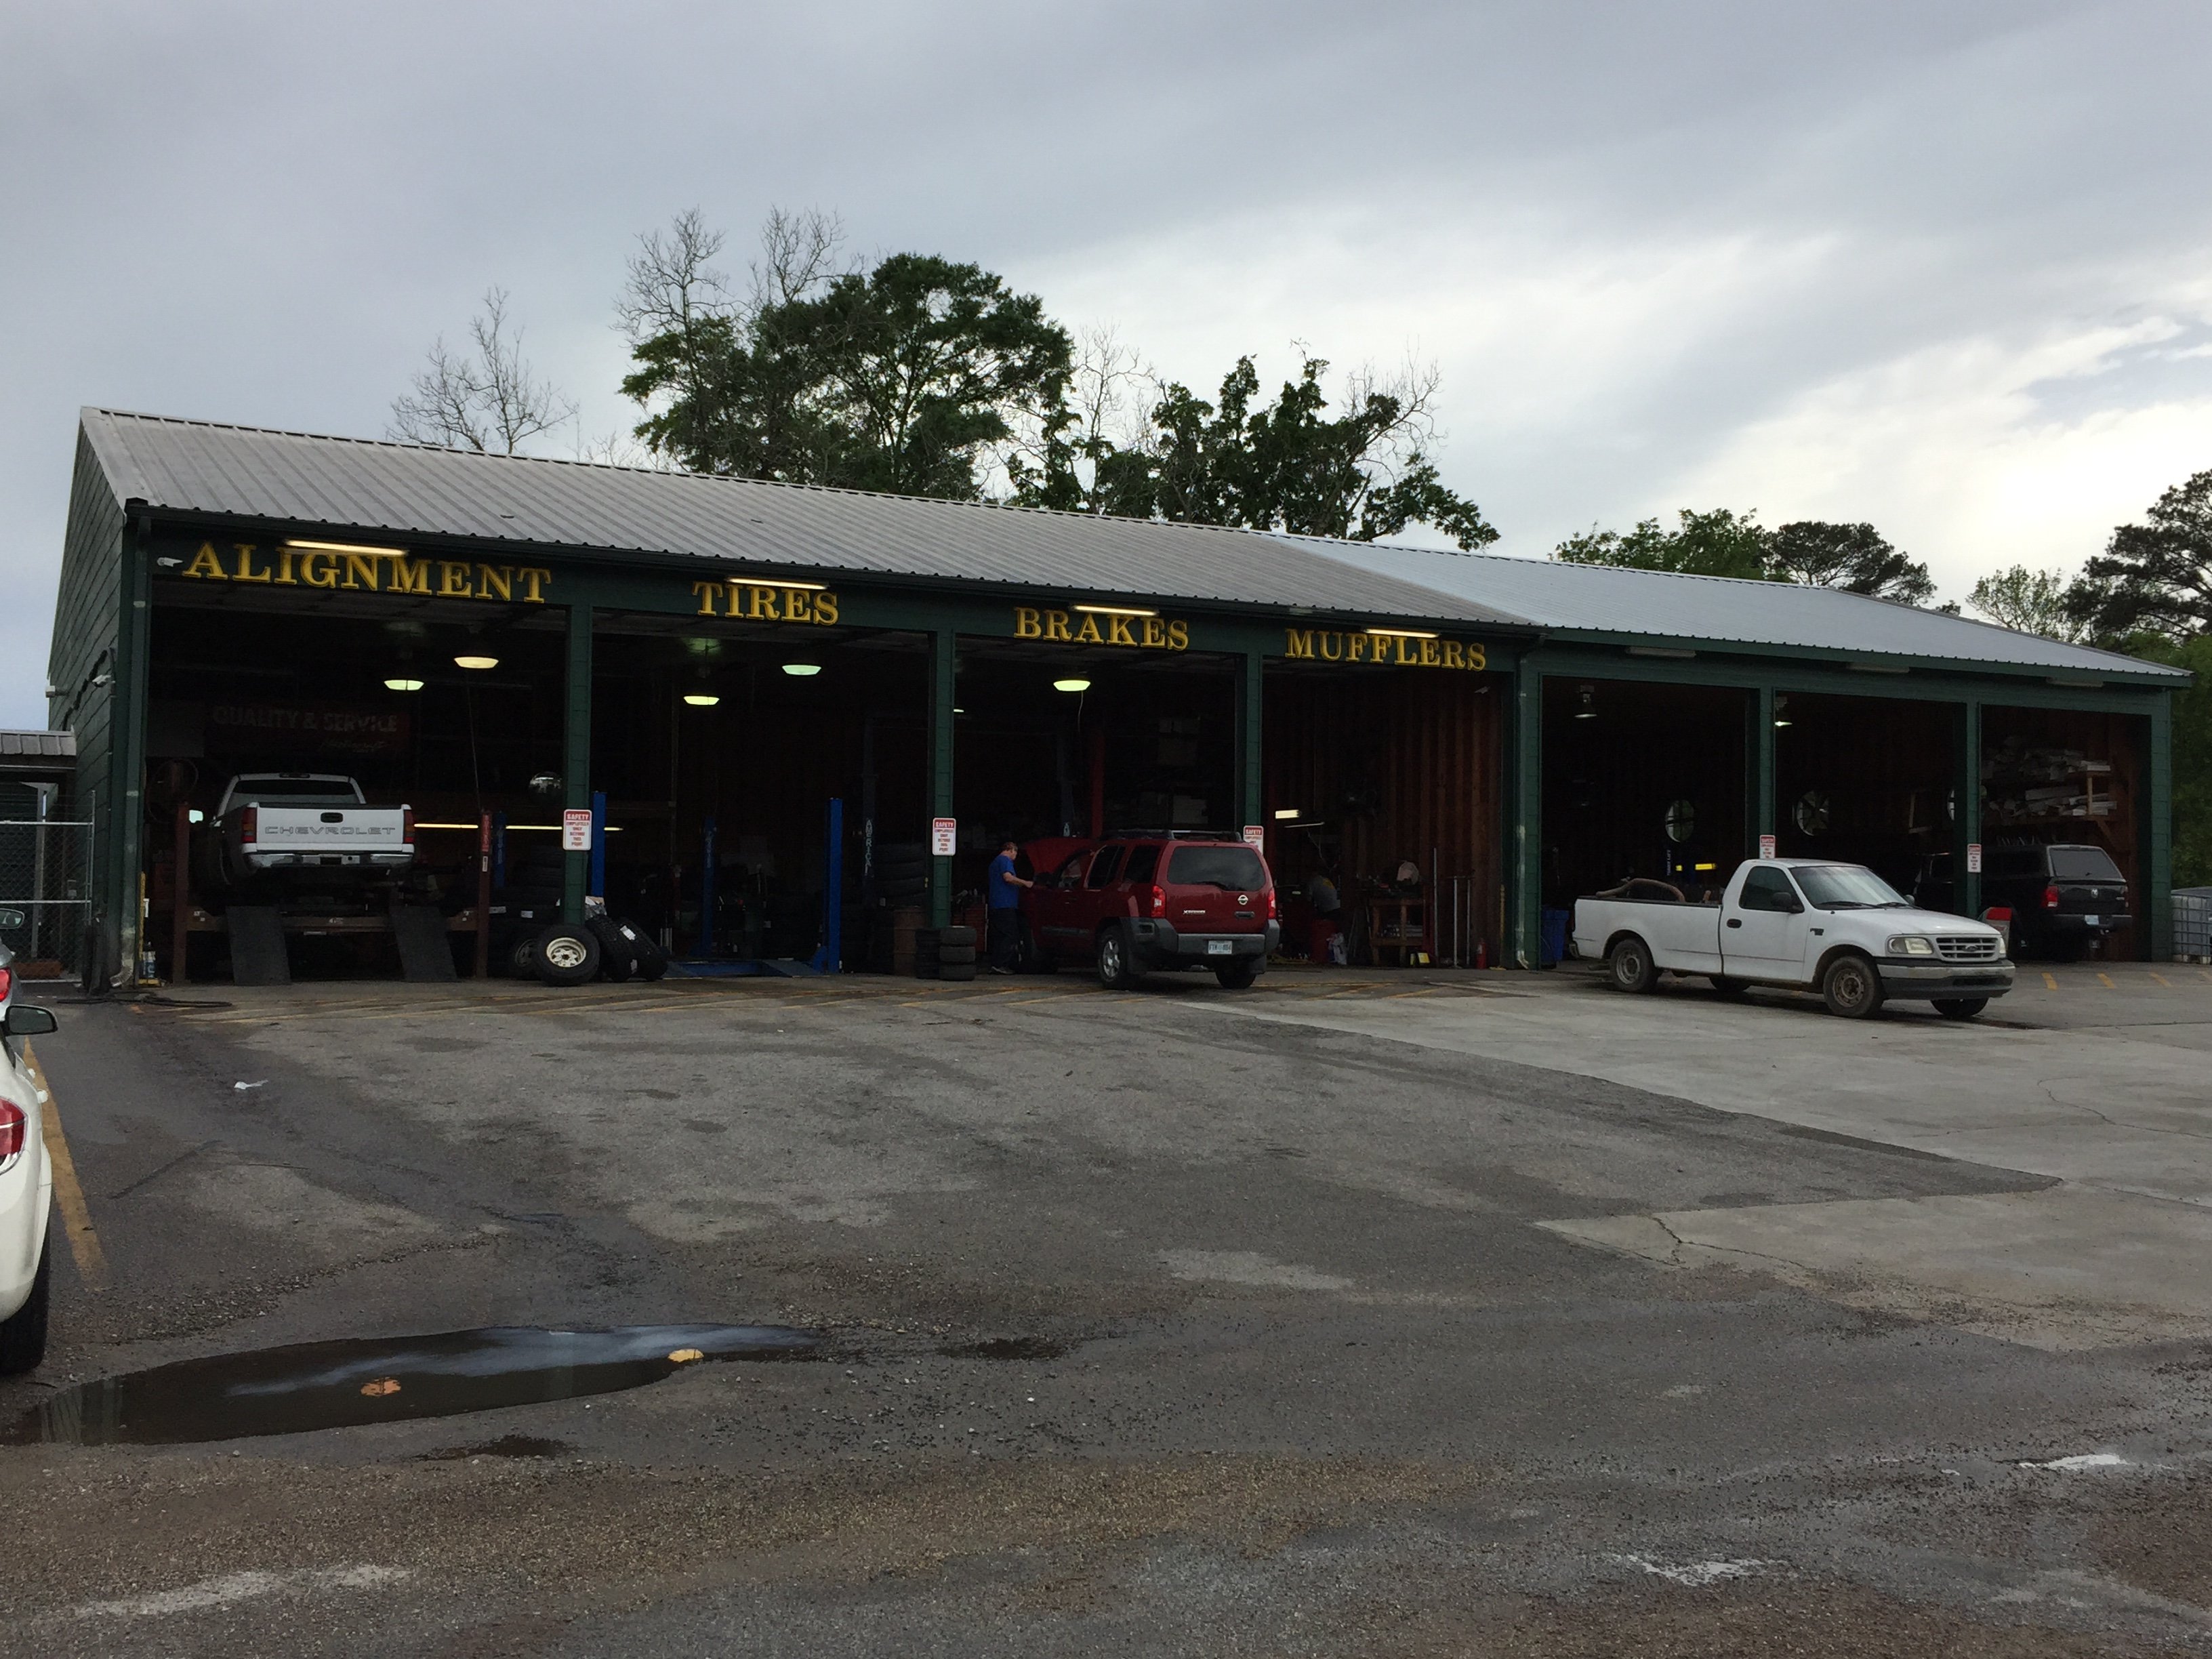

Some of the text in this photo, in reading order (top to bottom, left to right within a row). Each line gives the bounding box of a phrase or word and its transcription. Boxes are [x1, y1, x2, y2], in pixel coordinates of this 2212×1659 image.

[182, 542, 552, 604] ALIGNMENT
[692, 581, 839, 626] TIRES
[1013, 607, 1189, 651] BRAKES
[1284, 628, 1486, 672] MUFFLERS
[212, 706, 398, 733] QUALITY & SERVICE
[265, 826, 396, 836] CHEVROLET
